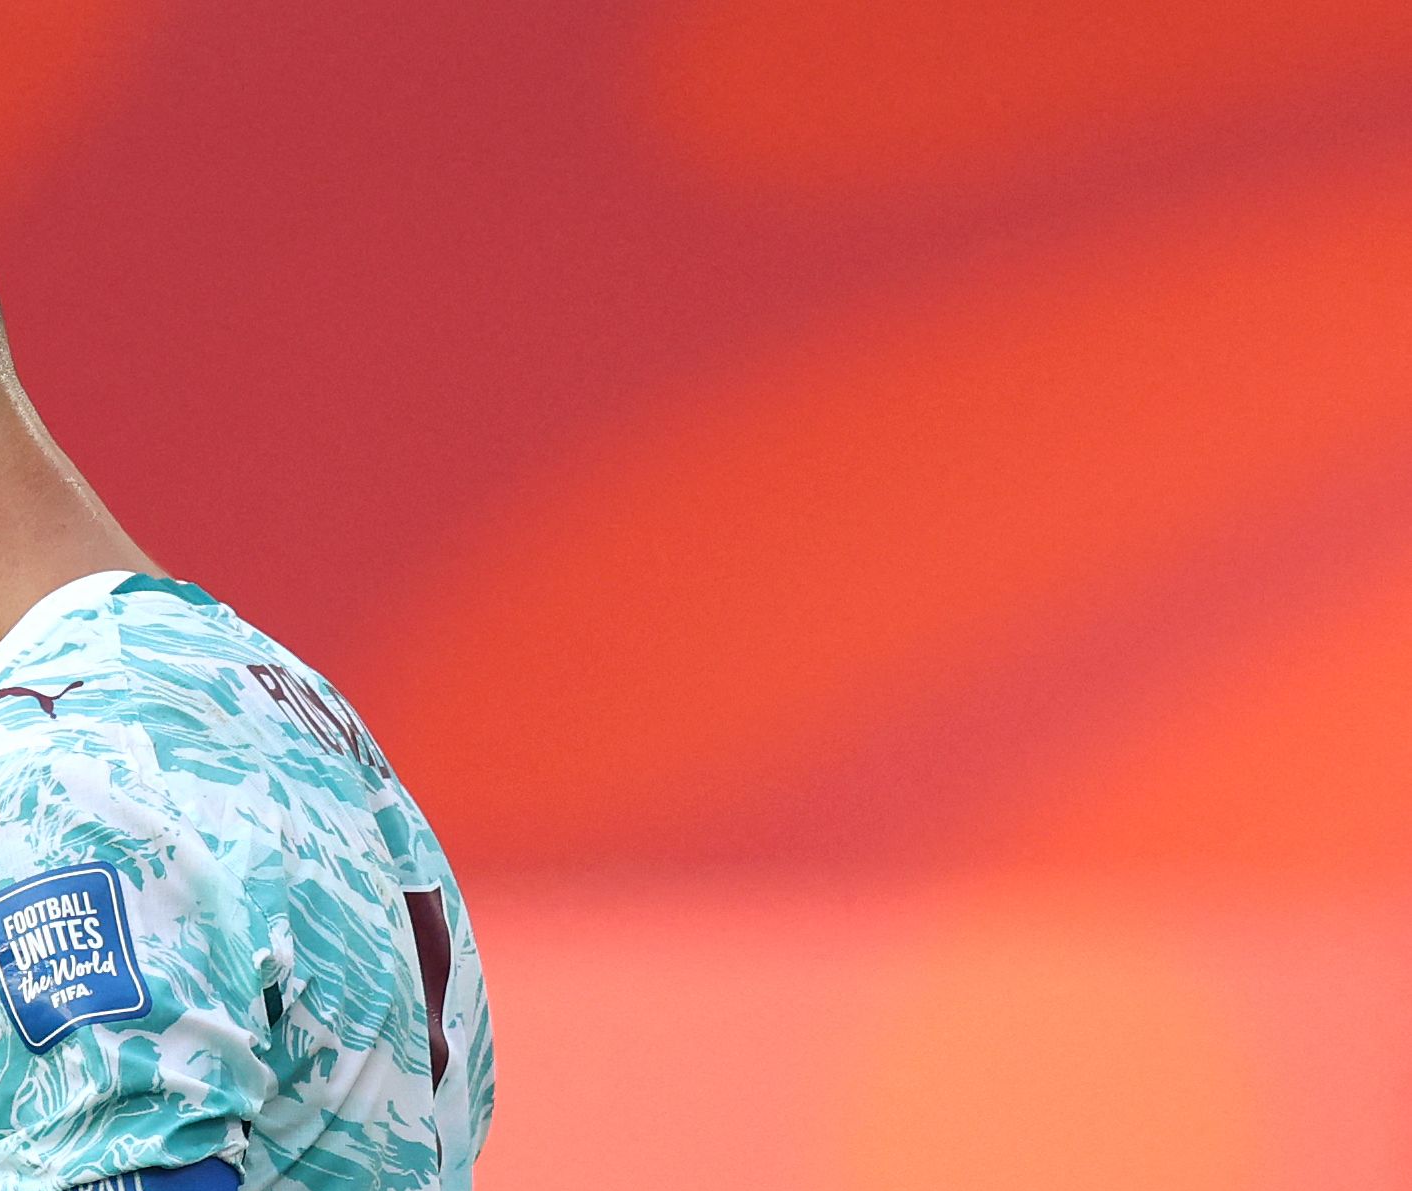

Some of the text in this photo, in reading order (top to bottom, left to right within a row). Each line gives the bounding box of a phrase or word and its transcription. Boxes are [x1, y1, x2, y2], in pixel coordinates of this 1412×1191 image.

[3, 891, 98, 939] FOOTBALL
[9, 917, 104, 971] UNITES
[17, 951, 117, 1004] the World
[50, 983, 93, 1008] FIFA
